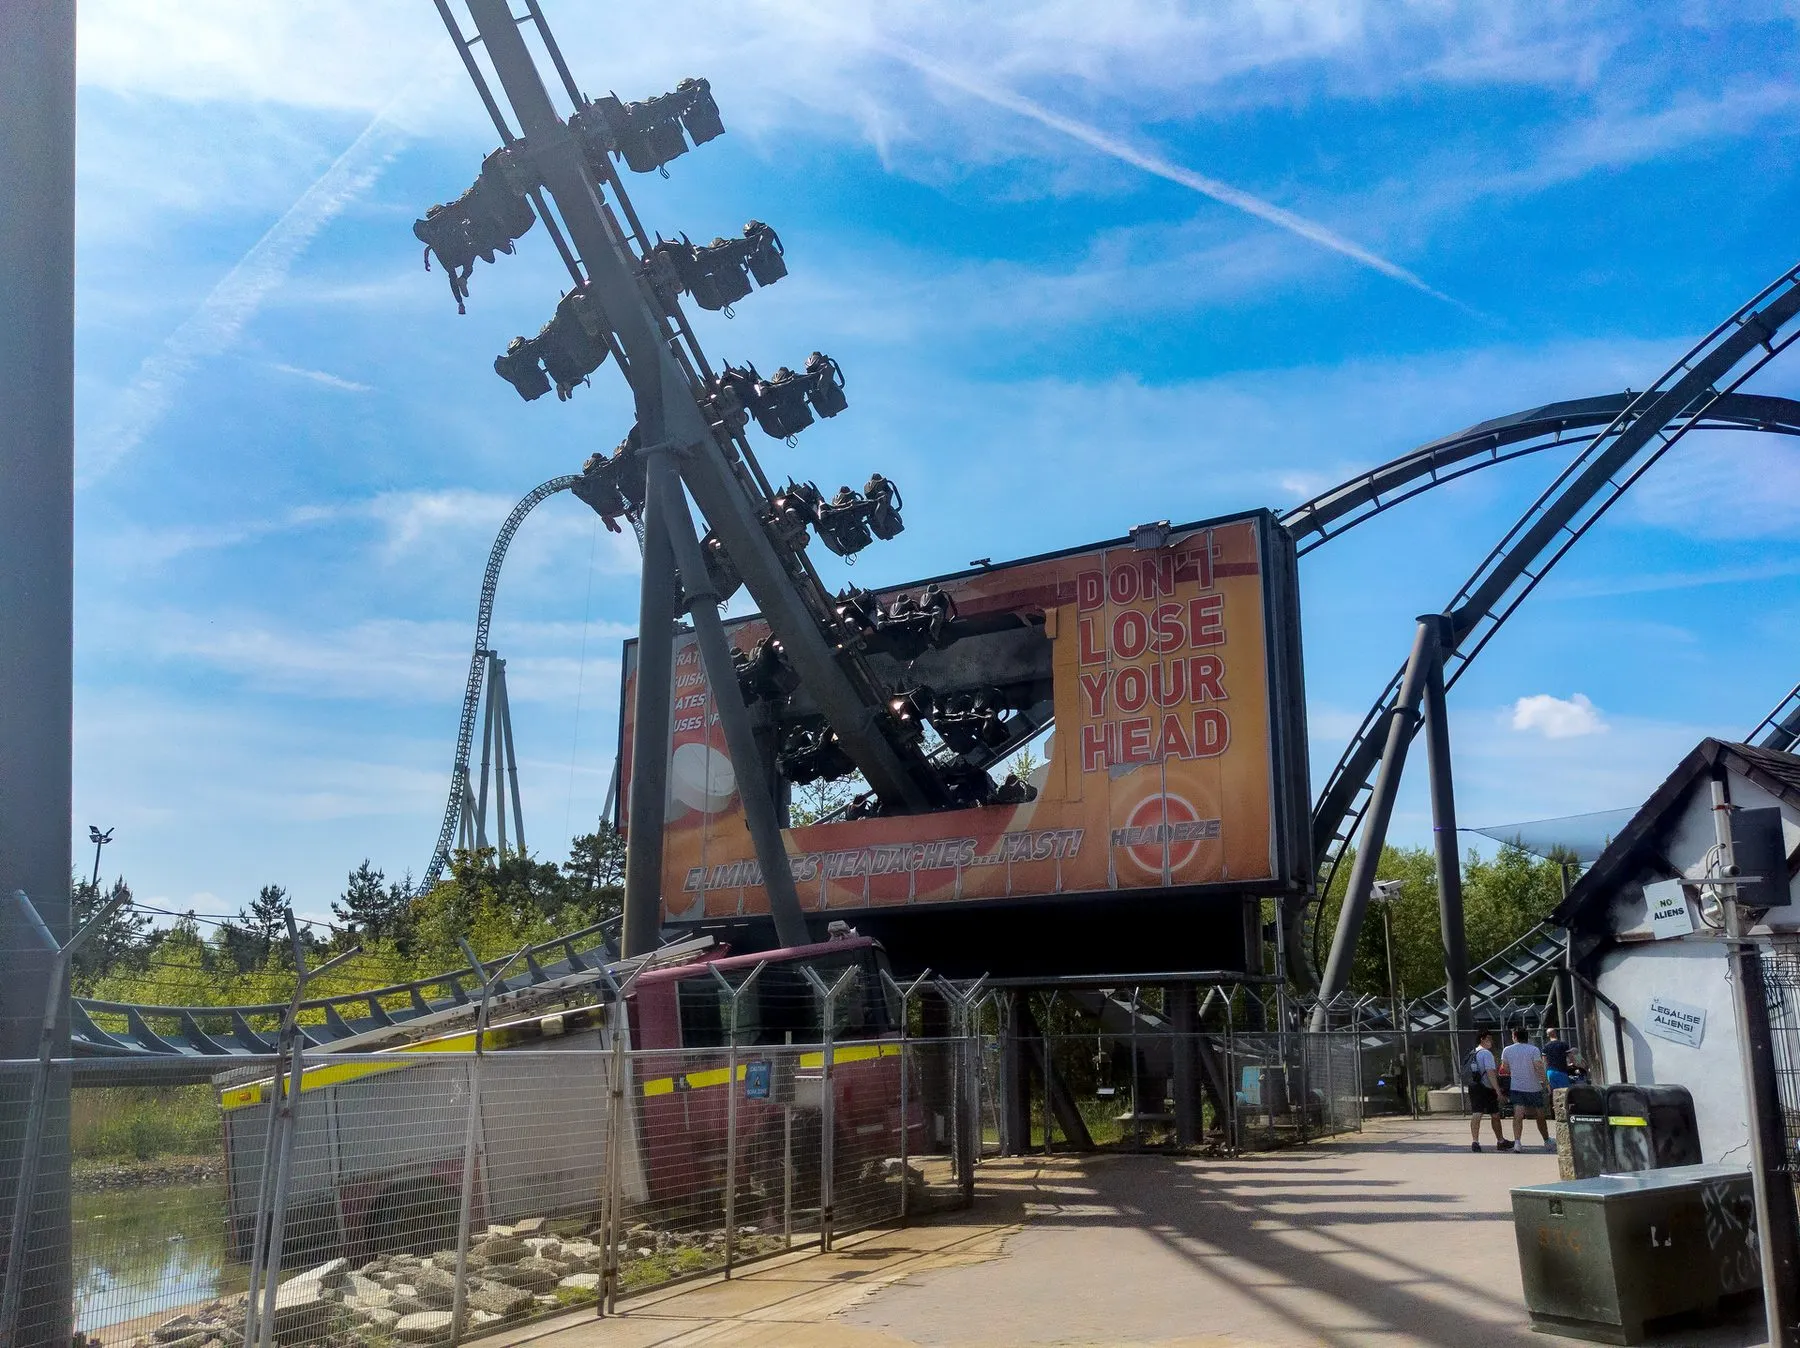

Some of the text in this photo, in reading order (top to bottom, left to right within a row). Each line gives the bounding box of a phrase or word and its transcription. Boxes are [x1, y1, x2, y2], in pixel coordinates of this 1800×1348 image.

[1078, 545, 1221, 612] DON'T
[1079, 593, 1225, 667] LOSE
[674, 693, 706, 710] ATES
[1080, 654, 1228, 718] YOUR
[1081, 708, 1230, 772] HEAD
[682, 853, 820, 893] ELIMINES
[1653, 907, 1685, 921] ALIENS
[1660, 898, 1673, 908] NO
[1651, 1004, 1701, 1025] LEGALISE
